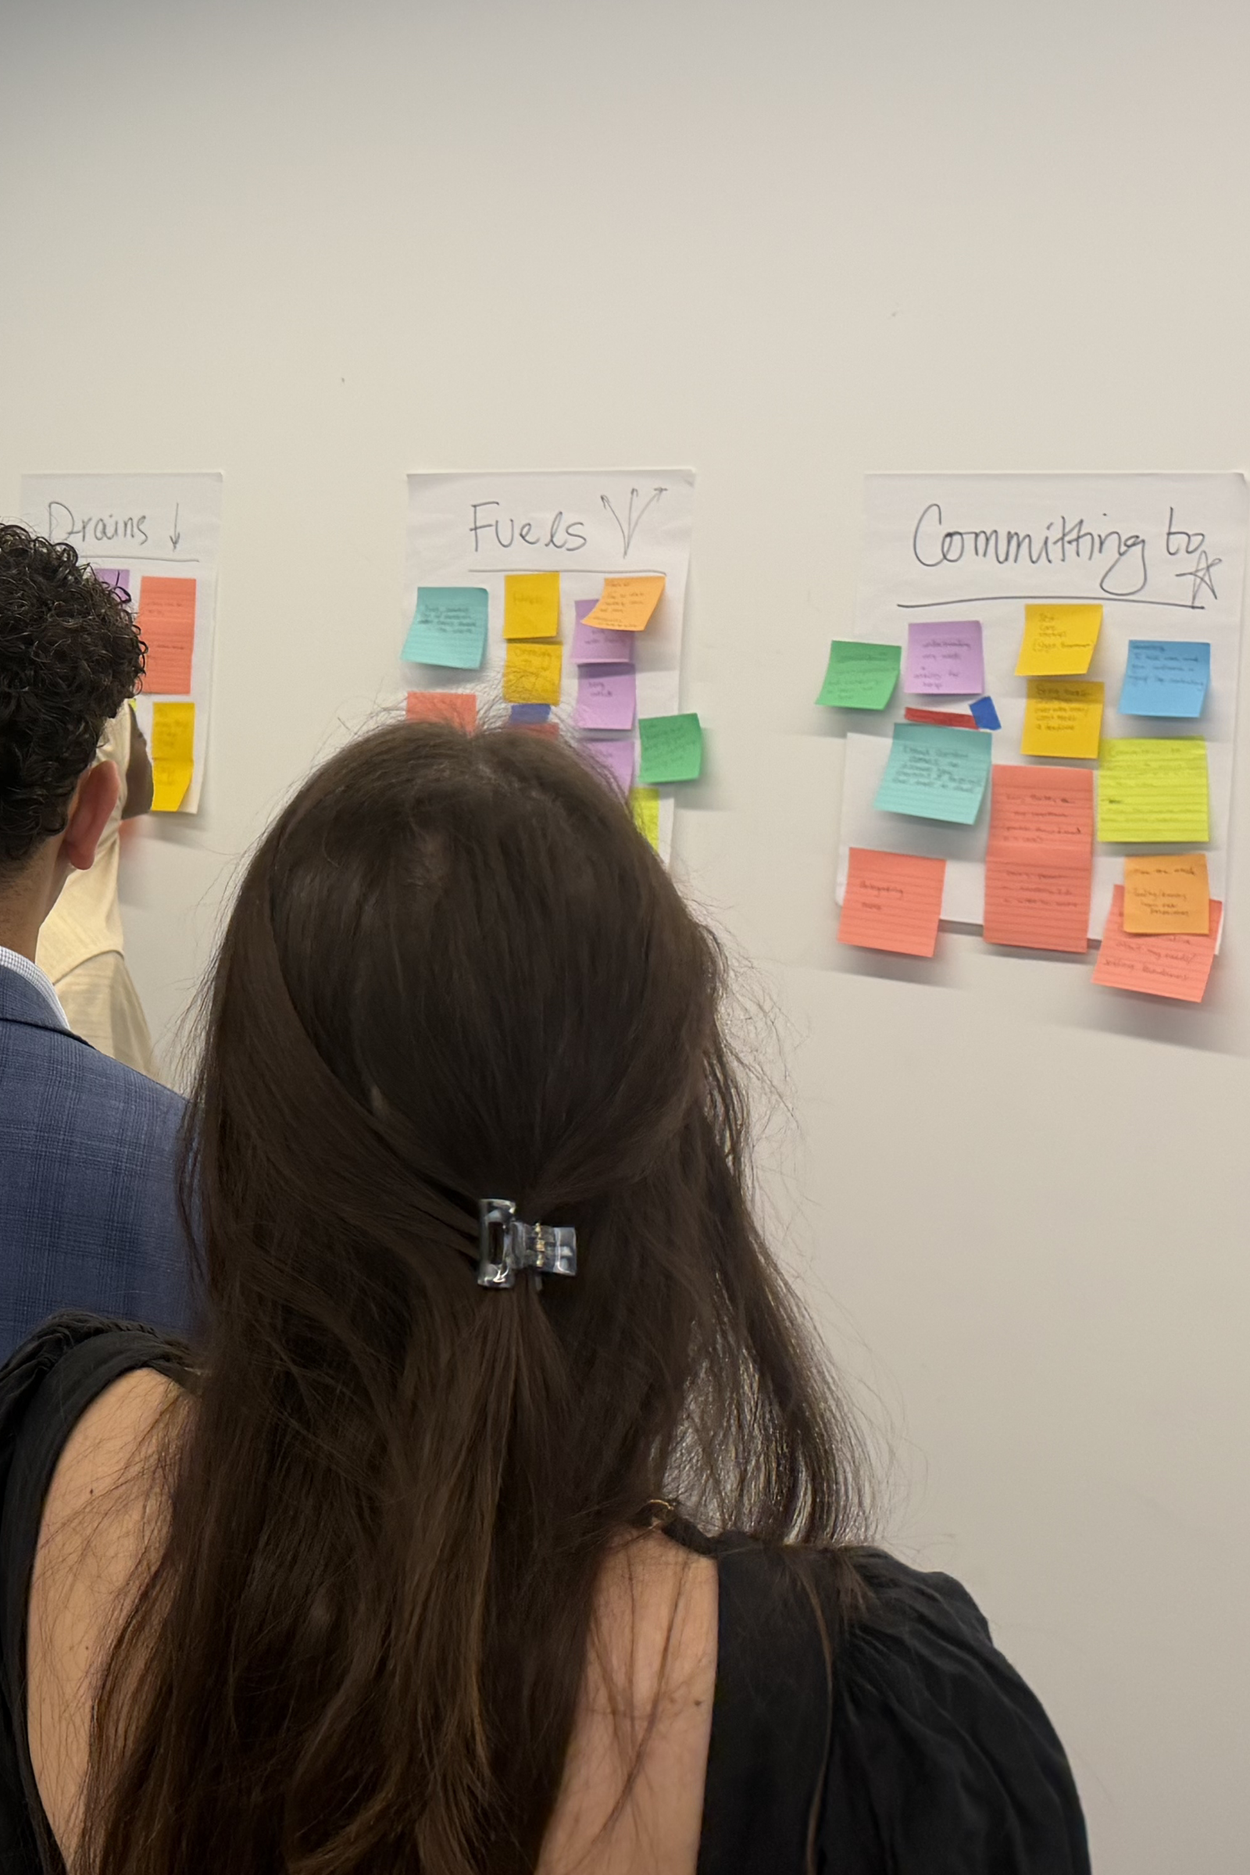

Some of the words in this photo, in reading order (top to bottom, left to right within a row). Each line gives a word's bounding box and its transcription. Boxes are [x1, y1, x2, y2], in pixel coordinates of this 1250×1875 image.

[48, 501, 149, 546] Drains
[468, 500, 588, 553] Fuels
[913, 503, 1148, 597] Committing
[1165, 505, 1206, 556] to
